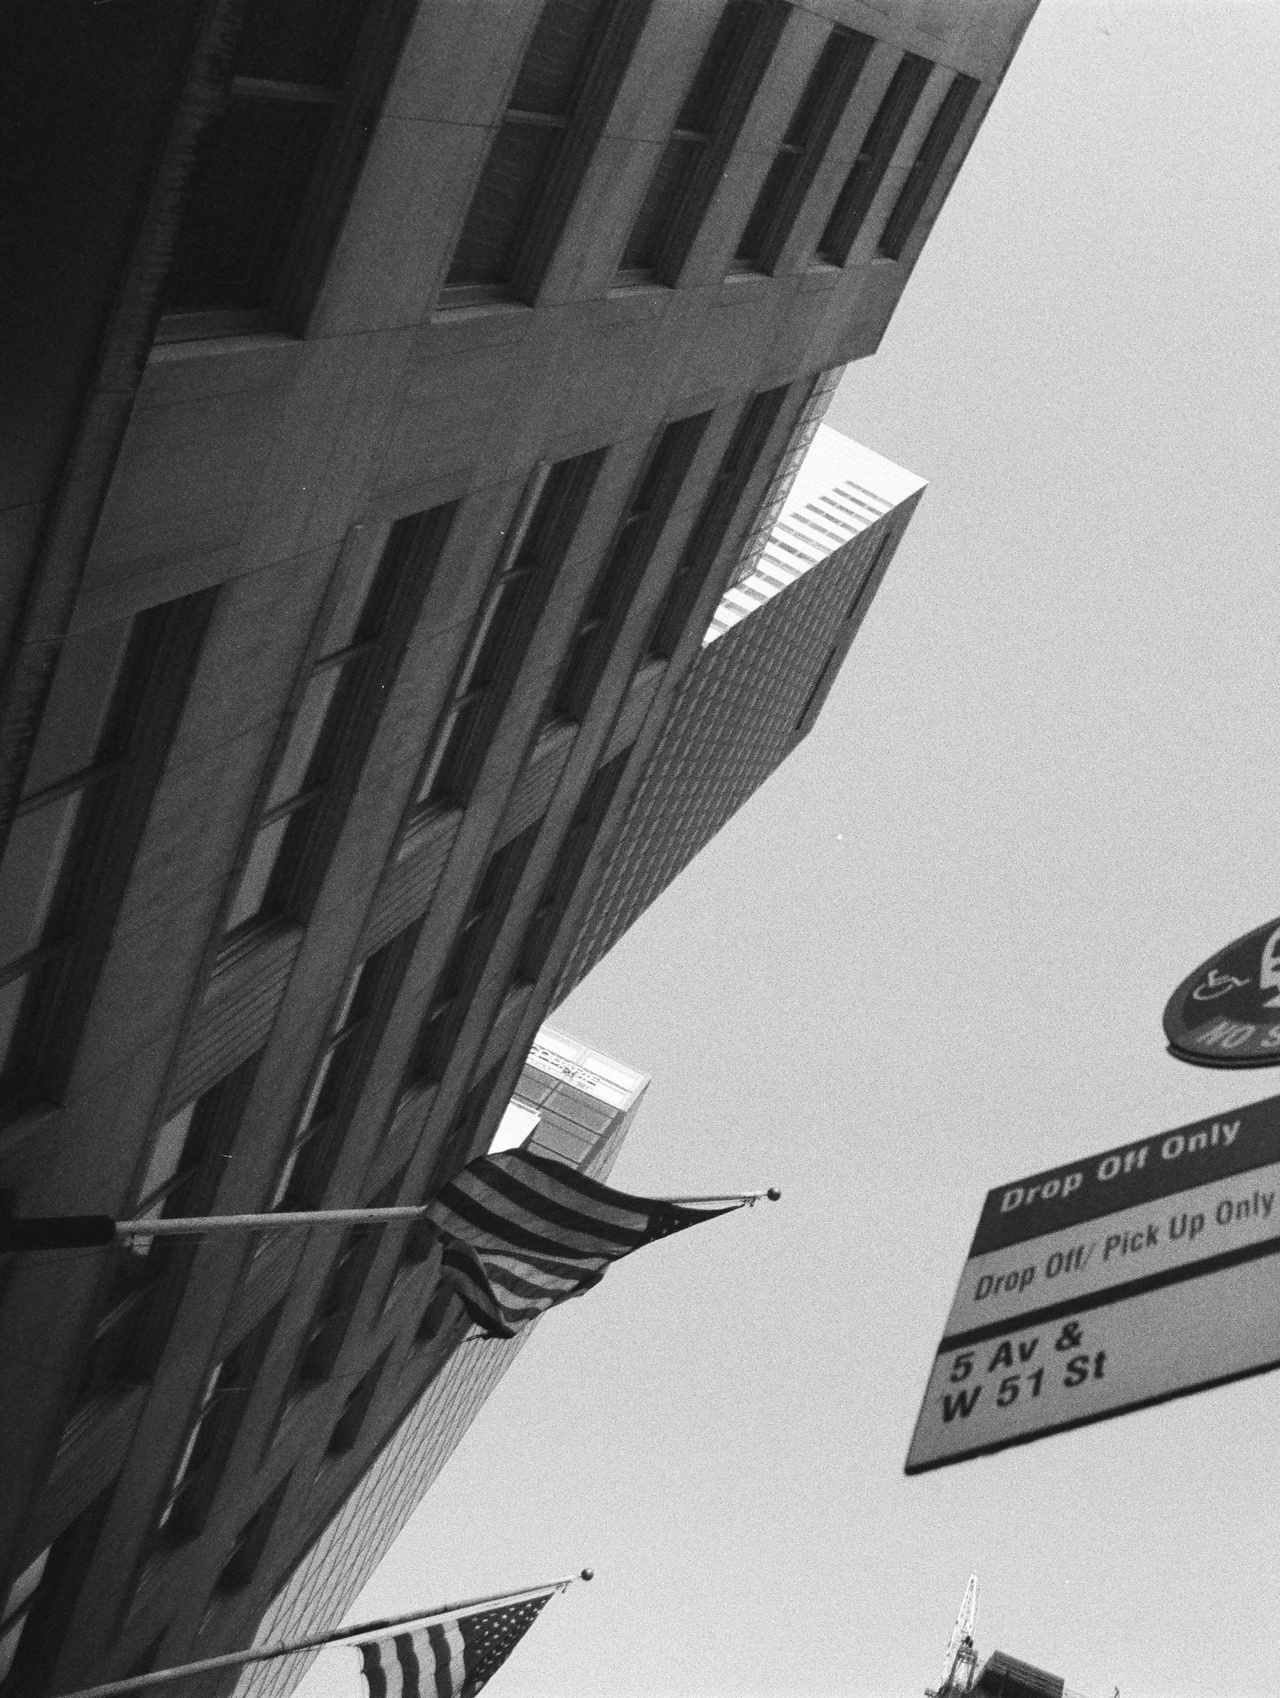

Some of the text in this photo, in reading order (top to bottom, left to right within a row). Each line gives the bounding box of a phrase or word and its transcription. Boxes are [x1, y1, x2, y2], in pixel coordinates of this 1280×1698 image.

[1196, 1020, 1256, 1048] NO
[1000, 1120, 1242, 1213] Drop Off Only
[973, 1190, 1276, 1302] Drop Off/ Pick Up Only
[942, 1350, 1106, 1424] W 51 St
[950, 1319, 1083, 1383] 5 Av &
